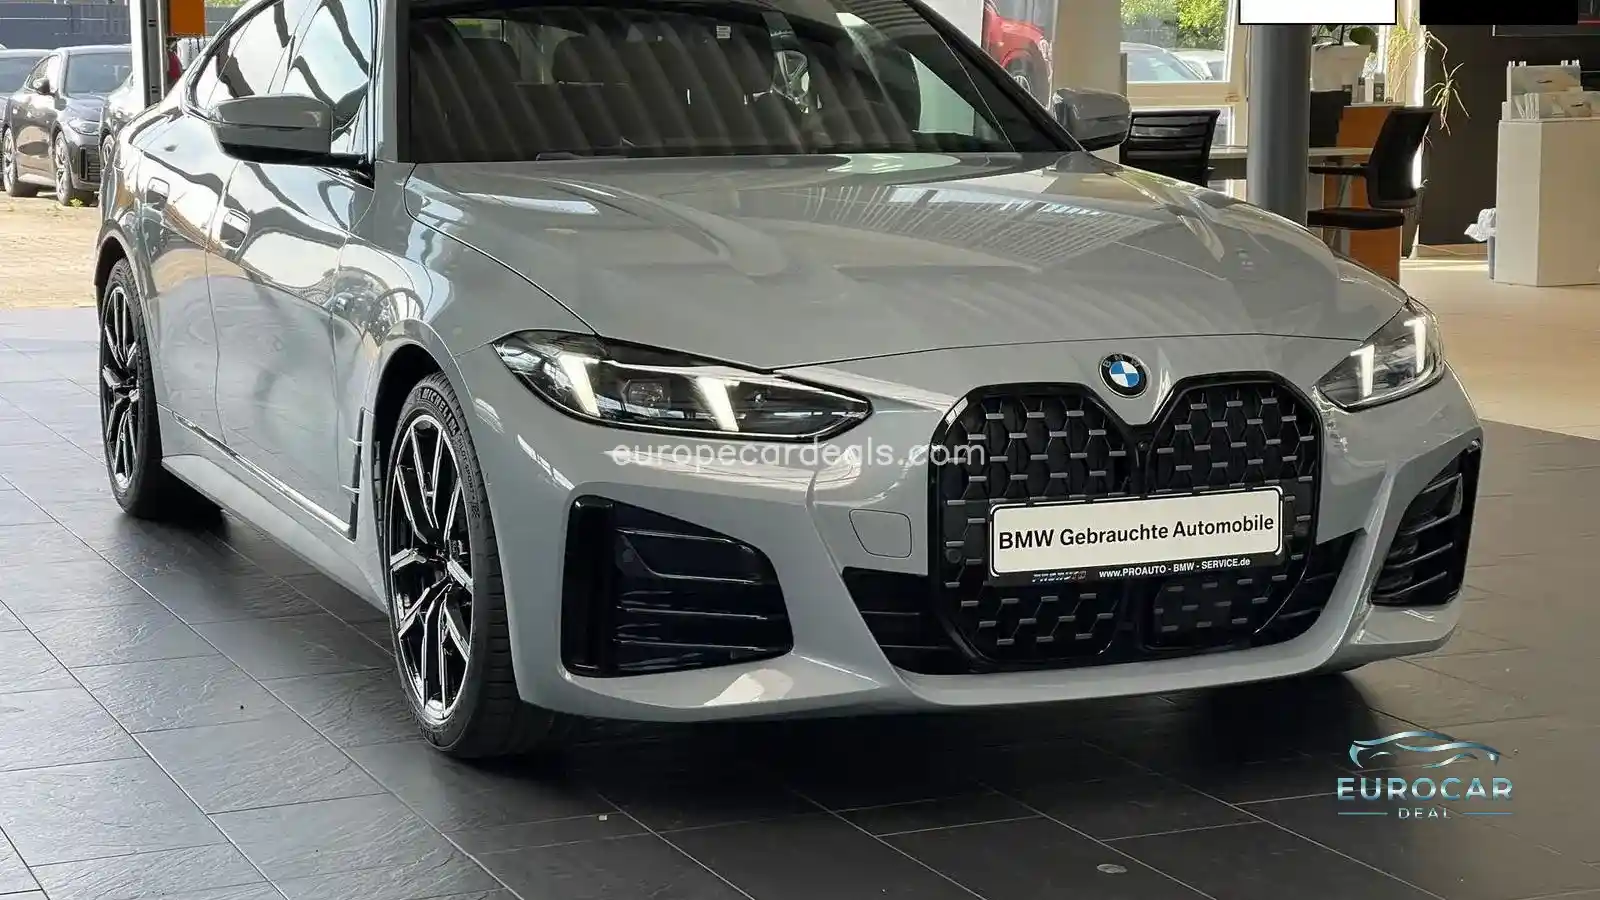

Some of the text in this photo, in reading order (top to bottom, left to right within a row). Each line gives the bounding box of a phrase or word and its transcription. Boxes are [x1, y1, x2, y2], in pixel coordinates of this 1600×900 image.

[1103, 354, 1140, 368] BMW
[421, 388, 460, 437] MICHELIN
[999, 513, 1274, 550] BMW Gebrauchte Automobile
[1099, 565, 1166, 578] www.PROAUTO
[1173, 562, 1195, 573] BMW
[1201, 558, 1251, 570] SERVICE.de
